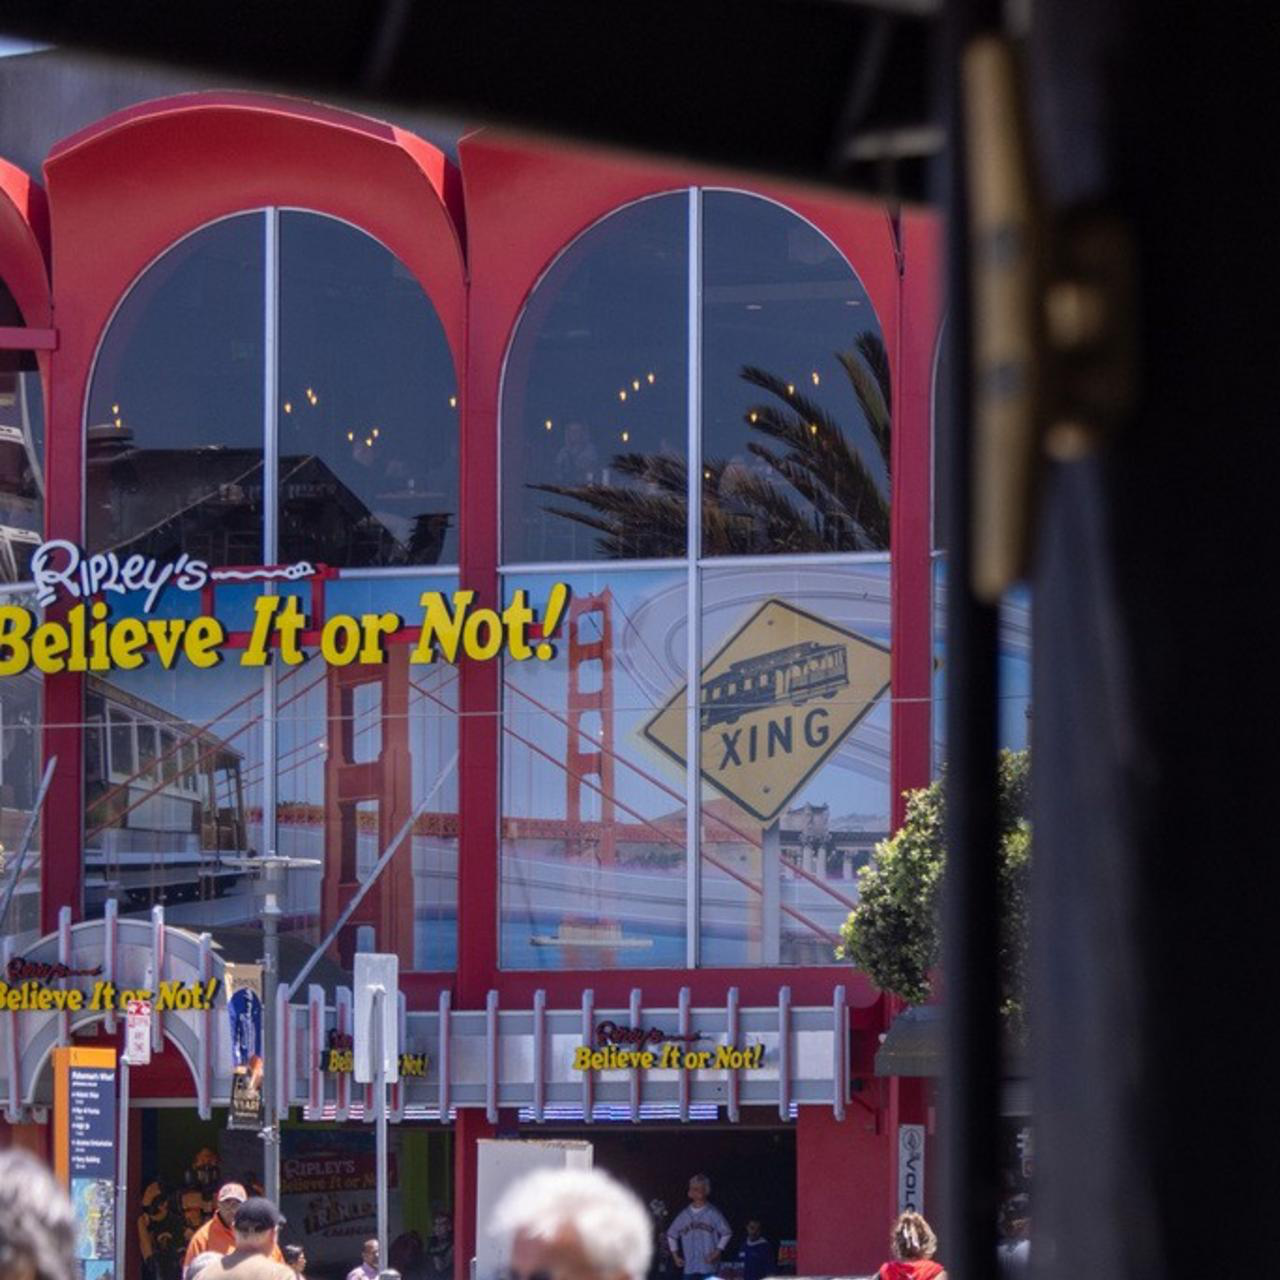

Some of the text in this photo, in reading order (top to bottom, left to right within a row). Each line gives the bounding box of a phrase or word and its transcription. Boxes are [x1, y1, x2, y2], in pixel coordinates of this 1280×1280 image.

[0, 583, 571, 676] Believe It or Not!
[719, 707, 830, 771] XING
[0, 981, 84, 1011] Believe
[89, 981, 116, 1011] It
[156, 976, 217, 1011] Not!
[573, 1042, 765, 1070] Believe It or Not!
